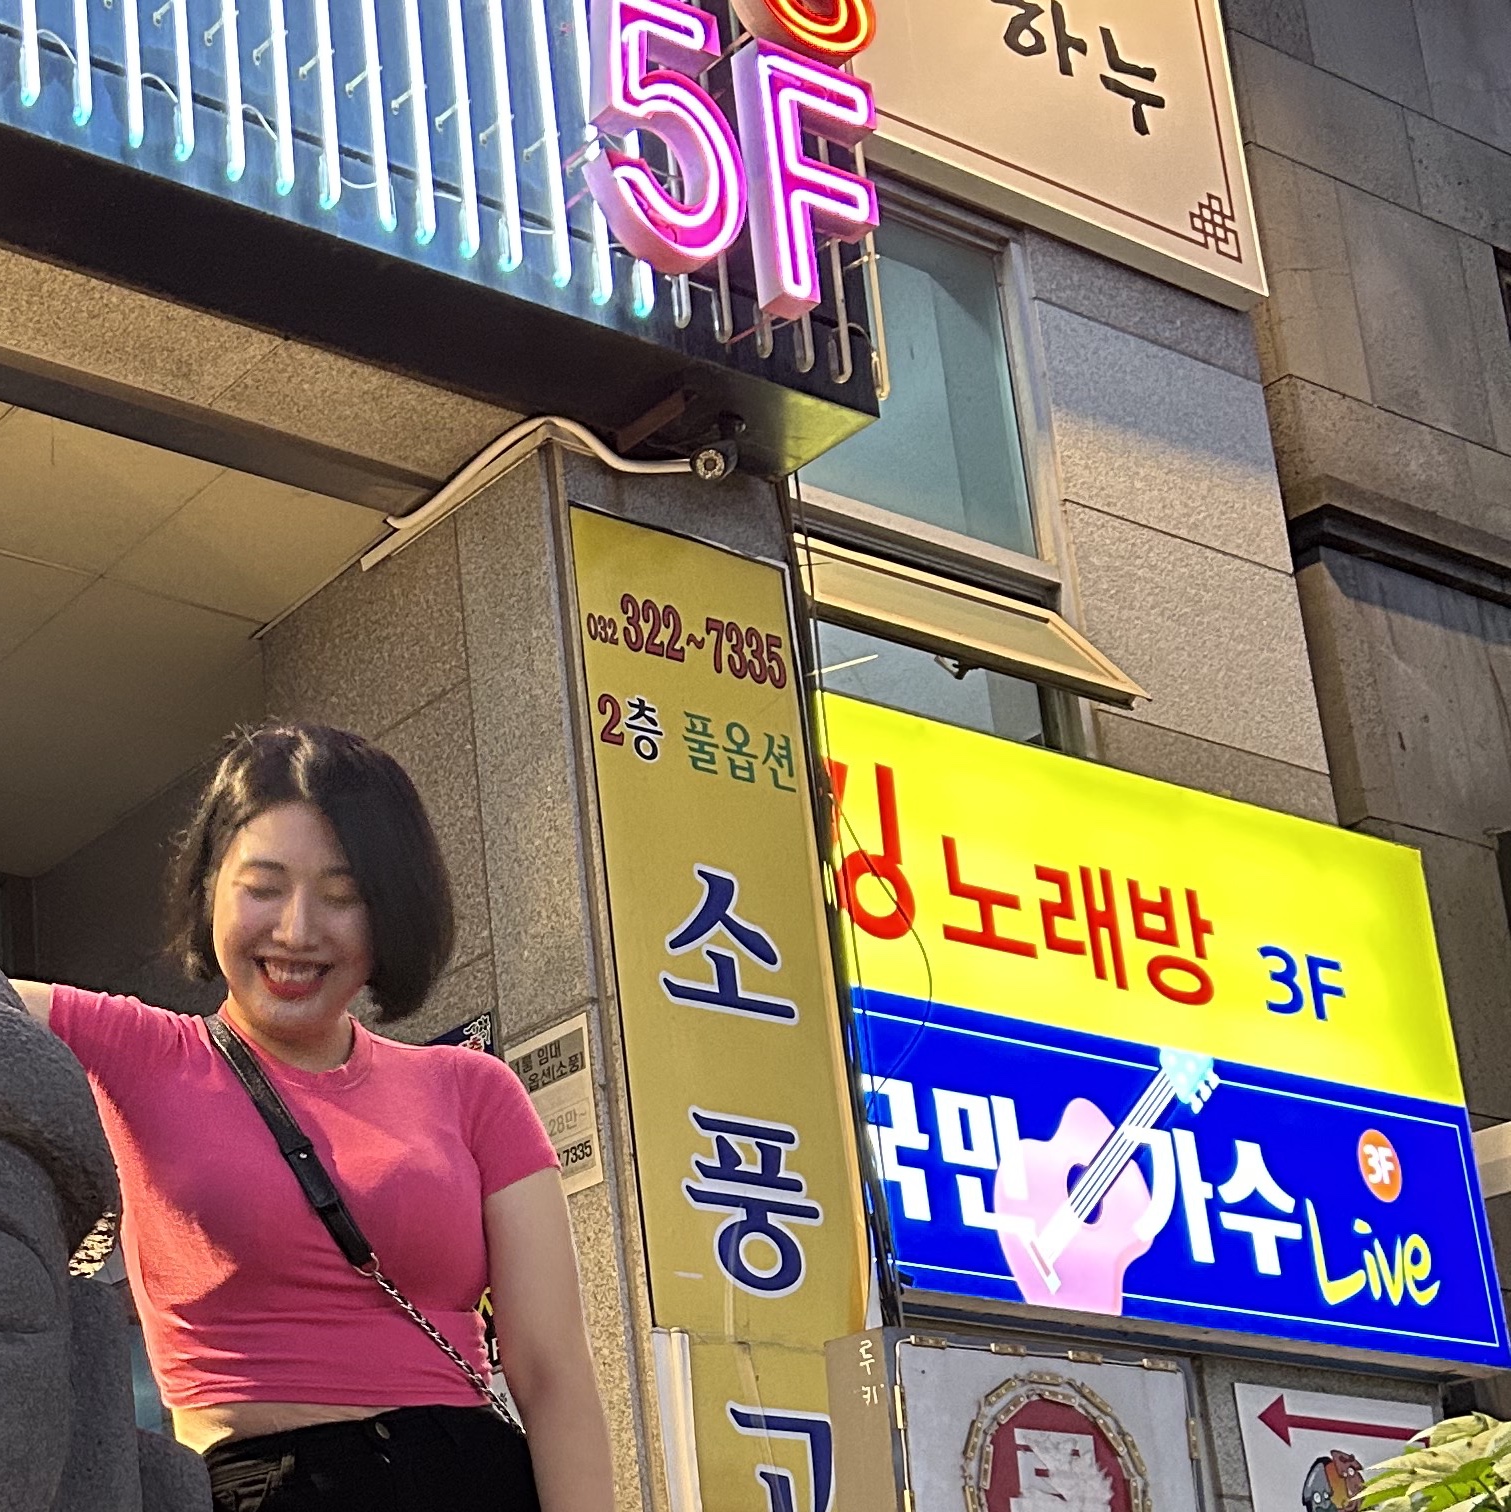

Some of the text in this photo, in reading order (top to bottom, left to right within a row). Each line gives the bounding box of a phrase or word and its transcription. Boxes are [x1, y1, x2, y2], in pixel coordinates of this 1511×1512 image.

[584, 0, 880, 319] 5F
[587, 612, 619, 646] 032
[597, 693, 797, 793] 2층 풀옵션
[941, 834, 1215, 1007] 노래방
[1257, 945, 1346, 1022] 3F
[537, 1038, 563, 1065] 임대
[1361, 1144, 1397, 1186] 3F
[1305, 1197, 1442, 1307] Live
